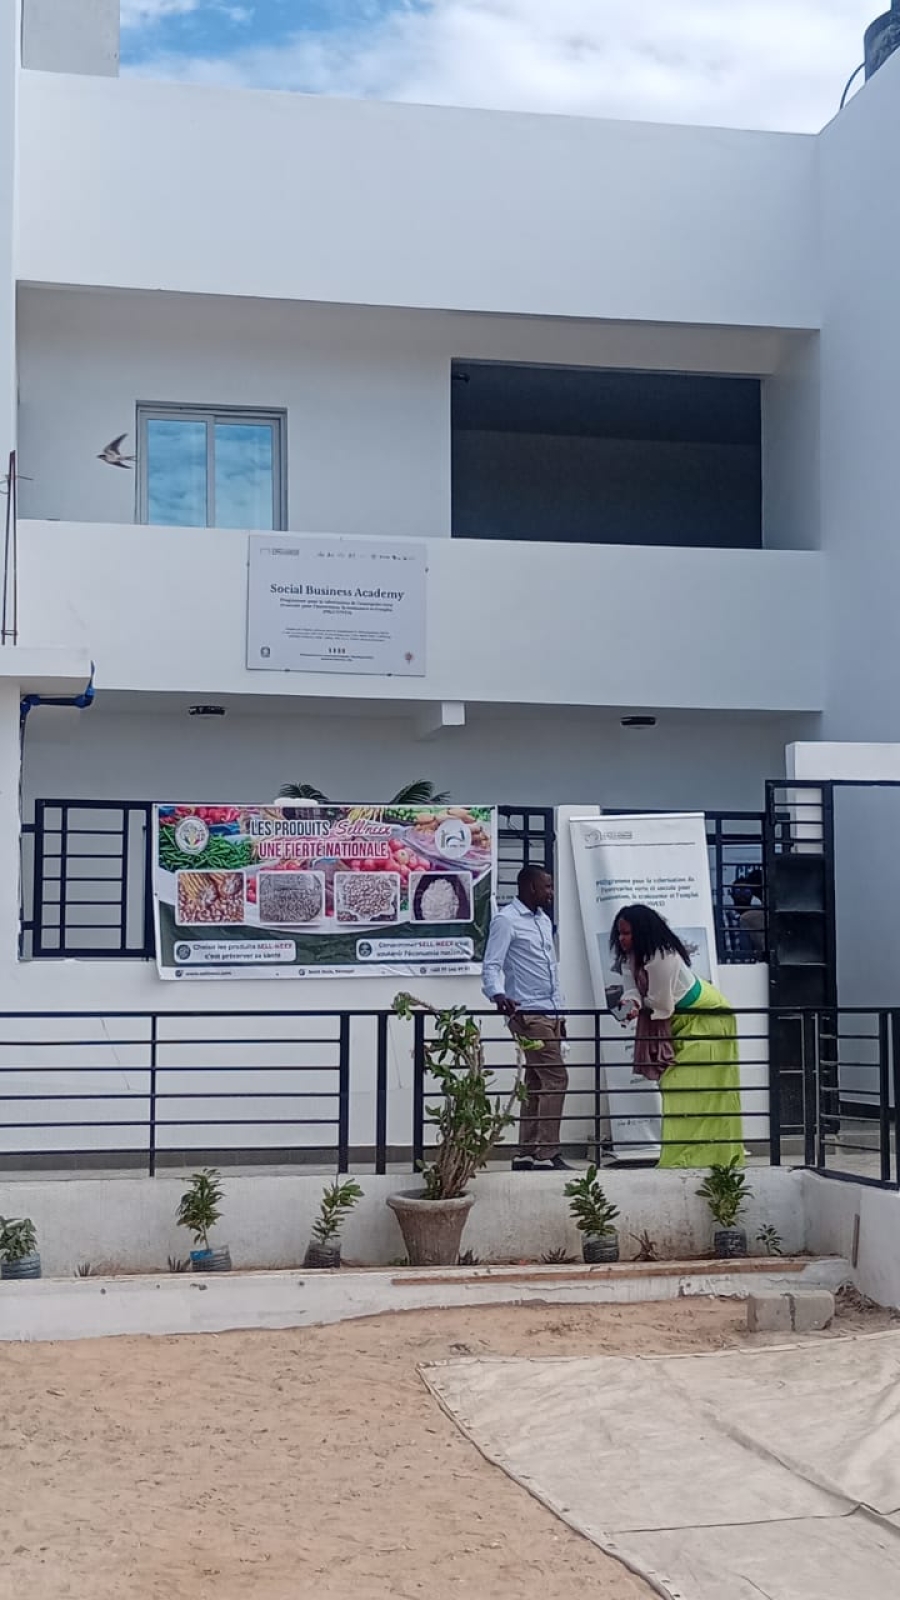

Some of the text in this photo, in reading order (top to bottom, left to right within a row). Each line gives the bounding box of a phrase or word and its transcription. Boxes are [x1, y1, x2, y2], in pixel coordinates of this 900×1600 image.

[270, 584, 405, 601] Social Business Academy
[251, 820, 271, 836] LES
[275, 820, 330, 836] PRODUITS
[260, 842, 281, 857] UNE
[325, 842, 387, 857] NATIONALE
